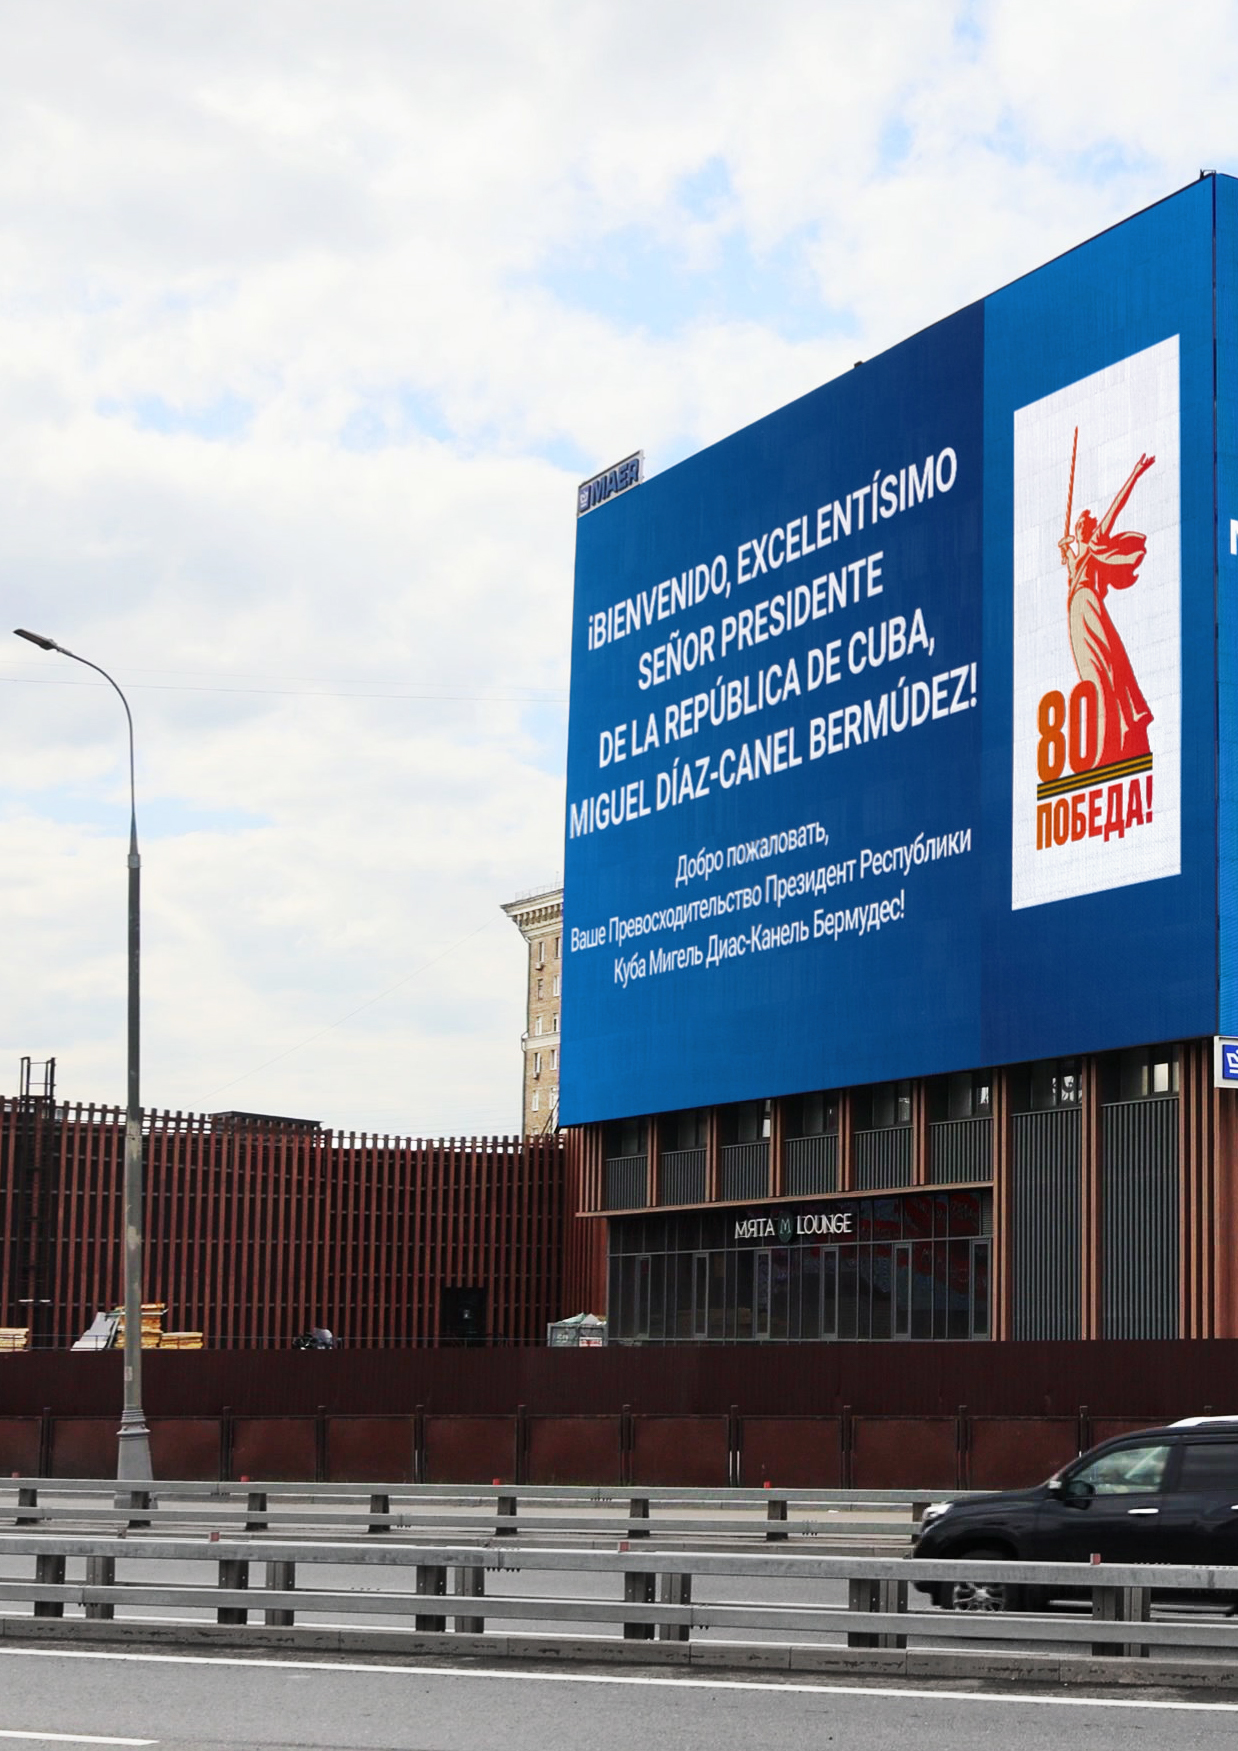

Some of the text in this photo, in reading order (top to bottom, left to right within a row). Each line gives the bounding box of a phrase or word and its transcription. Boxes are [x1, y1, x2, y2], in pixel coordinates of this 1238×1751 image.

[592, 458, 639, 506] MAER
[588, 447, 958, 651] ¡BIENVENIDO, EXCELENTÍSIMO
[638, 550, 884, 690] SEÑOR PRESIDENTE
[599, 607, 935, 769] DE LA REPÚBLICA DE CUBA,
[1037, 680, 1098, 783] 80
[570, 662, 977, 839] MIGUEL DÍAZ-CANEL BERMÚDEZ!
[675, 821, 829, 888] Добро пожаловать,
[1036, 774, 1153, 851] ПОБЕДА!
[571, 828, 972, 952] Ваше Превосходительство Президент Республики
[614, 889, 905, 989] Куба Мигель Диас-Канель Бермудес!
[734, 1218, 775, 1239] МЯТА
[796, 1213, 852, 1234] LOUNGE
